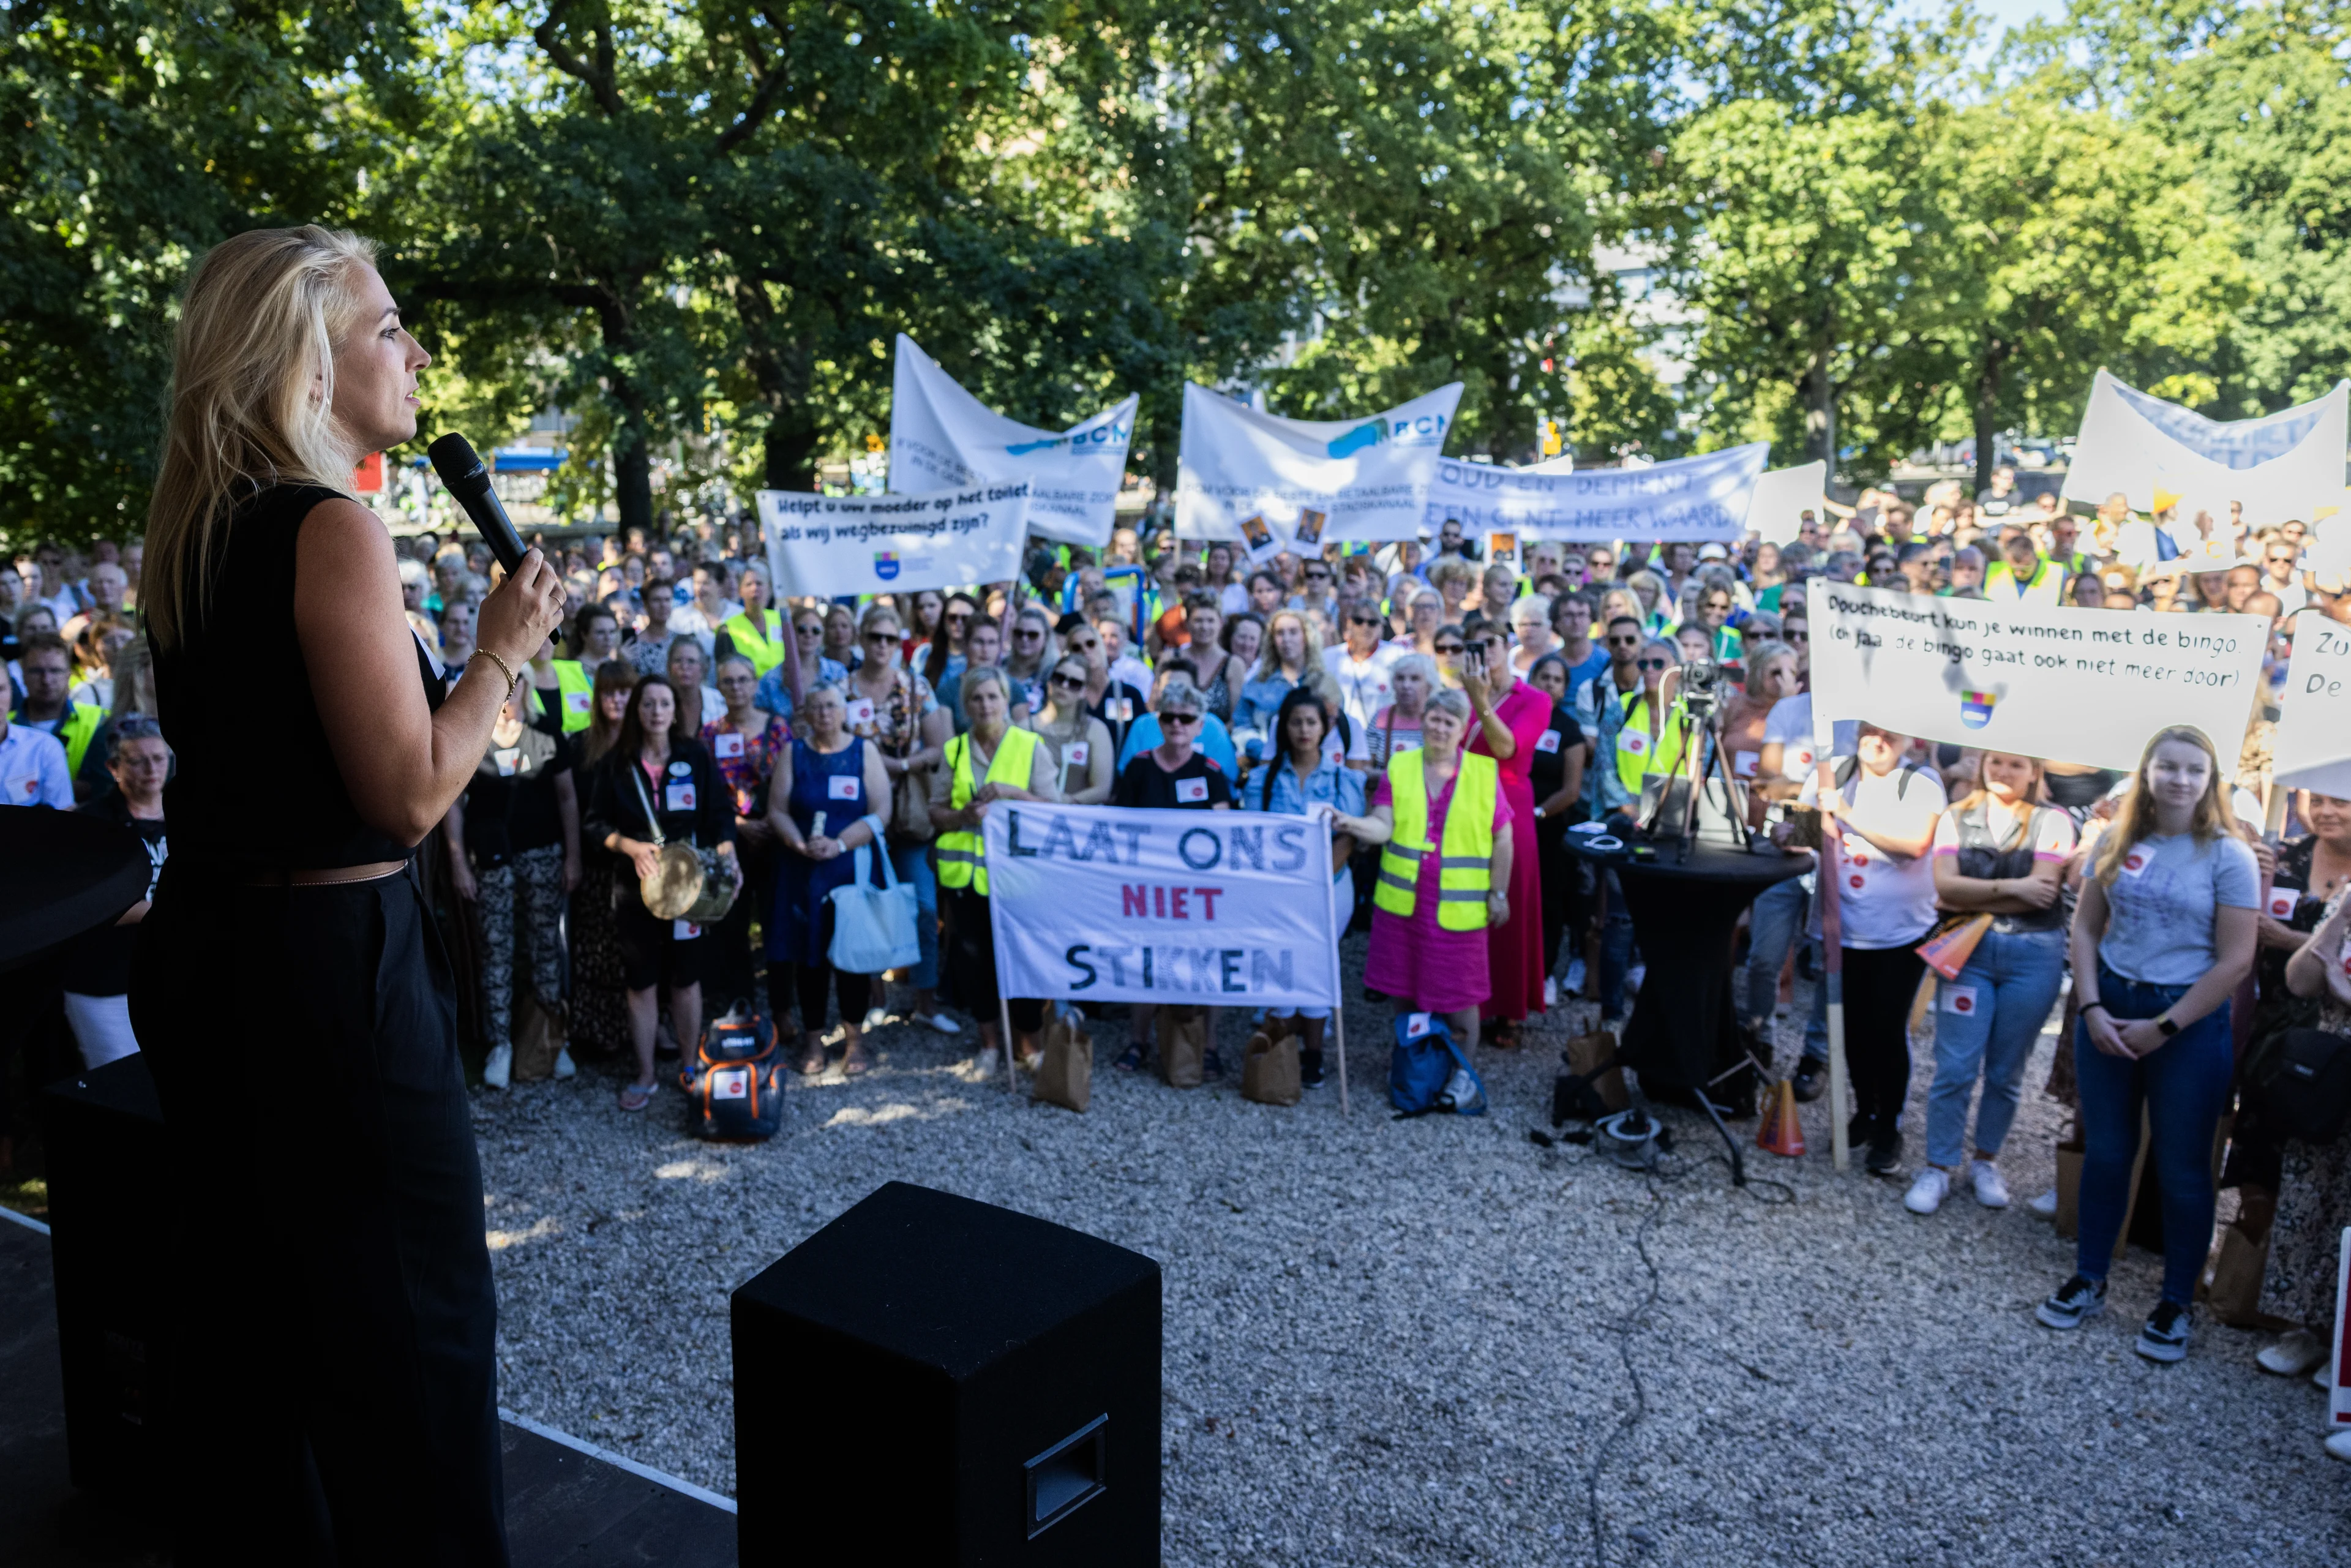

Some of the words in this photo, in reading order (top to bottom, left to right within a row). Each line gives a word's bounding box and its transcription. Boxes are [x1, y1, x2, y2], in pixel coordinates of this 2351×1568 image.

[1441, 463, 1504, 489] OUD
[1576, 471, 1695, 497] DEMENT
[778, 498, 821, 518] Helpt
[826, 502, 836, 512] u
[841, 502, 865, 513] uw
[870, 498, 929, 514] moeder
[934, 498, 953, 512] op
[958, 490, 983, 505] het
[988, 482, 1029, 502] toilet
[1574, 506, 1641, 529] MEER
[781, 525, 801, 541] als
[805, 523, 830, 544] wij
[834, 517, 947, 544] wegbezuinigd
[951, 512, 989, 536] zijn?
[1828, 595, 1940, 628] Douchebeurt
[1943, 613, 1977, 631] kun
[1982, 621, 2001, 637] je
[2009, 624, 2083, 641] winnen
[2092, 628, 2134, 645] met
[2142, 628, 2168, 646] de
[1895, 635, 1915, 650] de
[1924, 637, 1973, 664] bingo
[1981, 648, 2025, 667] gaat
[2034, 654, 2068, 669] ook
[2077, 658, 2116, 675] niet
[2125, 663, 2177, 680] meer
[2183, 666, 2240, 687] door)
[2315, 632, 2349, 656] Zu
[2306, 673, 2342, 697] De
[1008, 809, 1152, 865] LAAT
[1179, 823, 1308, 871] ONS
[1122, 884, 1223, 921] NIET
[1065, 944, 1295, 993] STIKKEN
